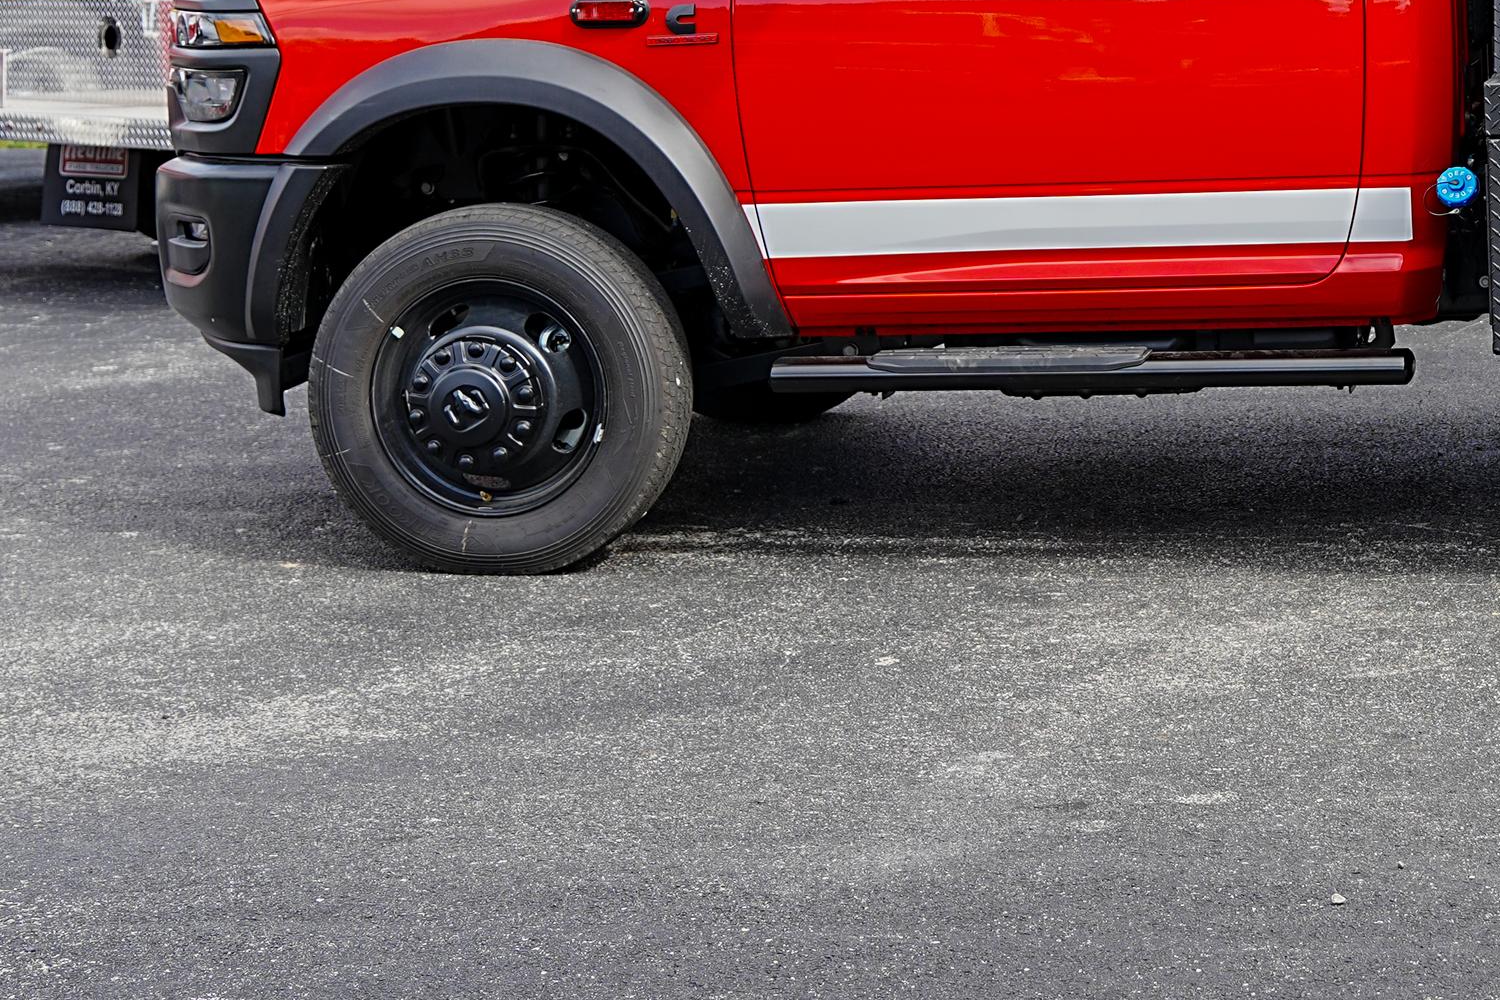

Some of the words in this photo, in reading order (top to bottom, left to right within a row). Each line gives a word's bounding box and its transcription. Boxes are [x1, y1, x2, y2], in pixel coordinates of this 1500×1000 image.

[1447, 170, 1465, 178] DEF
[65, 179, 104, 197] Corbin,
[105, 181, 120, 196] KY
